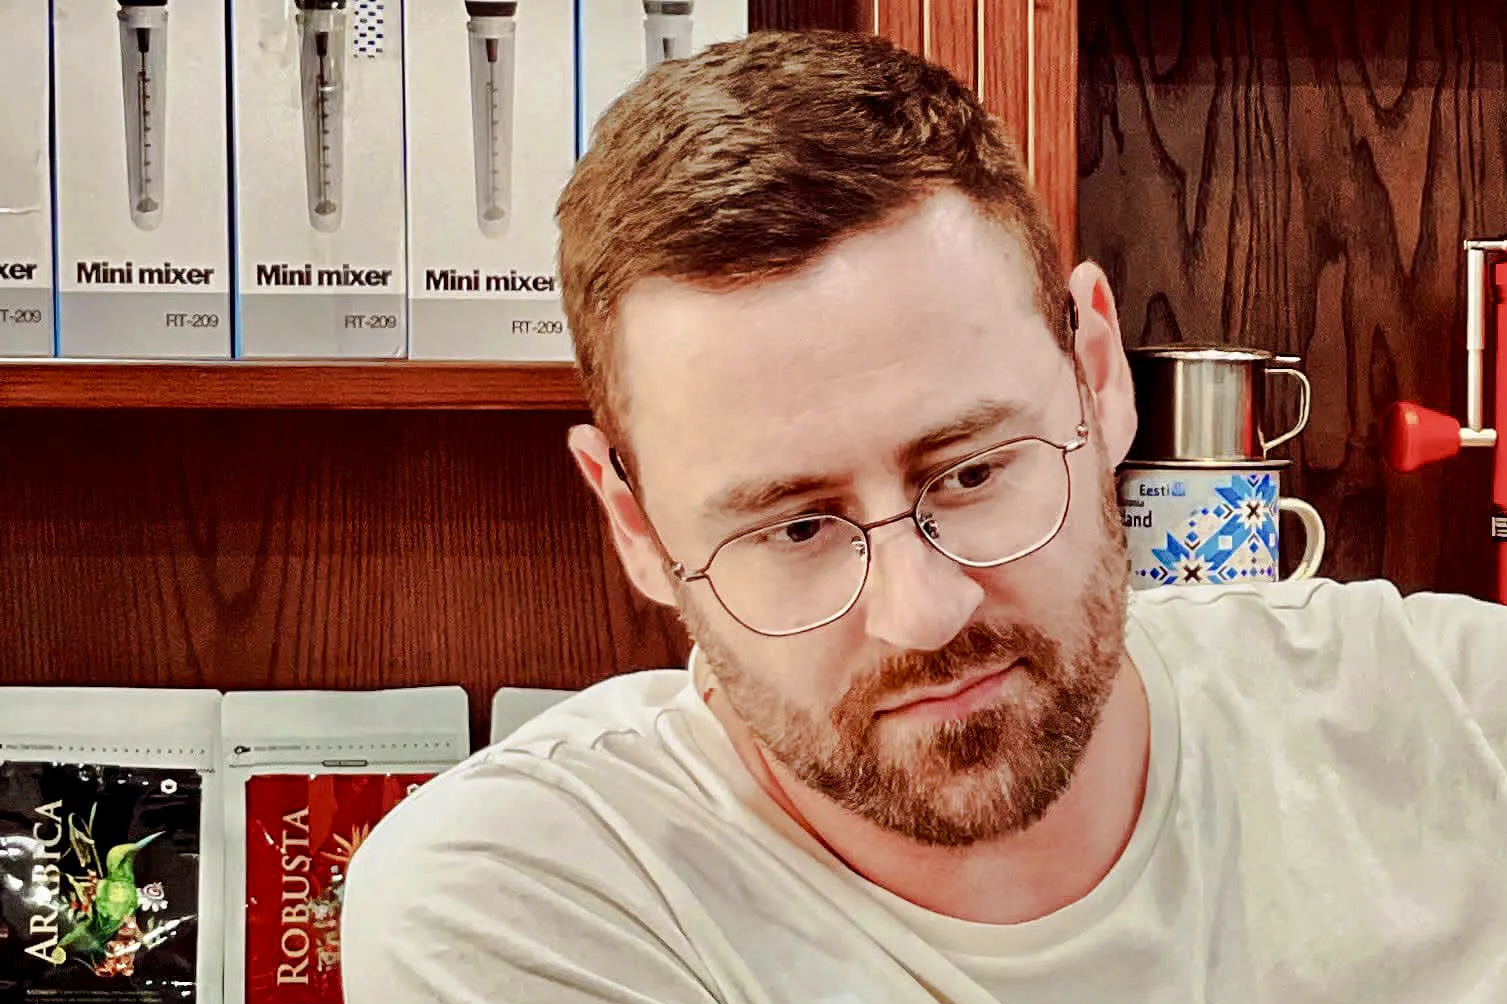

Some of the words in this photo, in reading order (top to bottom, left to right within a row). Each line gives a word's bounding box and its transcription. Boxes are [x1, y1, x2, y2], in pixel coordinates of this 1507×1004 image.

[77, 262, 133, 284] Mini
[138, 262, 214, 285] mixer
[256, 264, 312, 286] Mini
[317, 264, 392, 286] mixer
[426, 269, 479, 291] Mini
[166, 313, 219, 327] RT-209
[344, 314, 397, 329] RT-209
[511, 320, 563, 334] RT-209
[1140, 484, 1170, 497] Eesti
[24, 799, 64, 966] ARABICA
[277, 806, 313, 986] ROBUSTA
